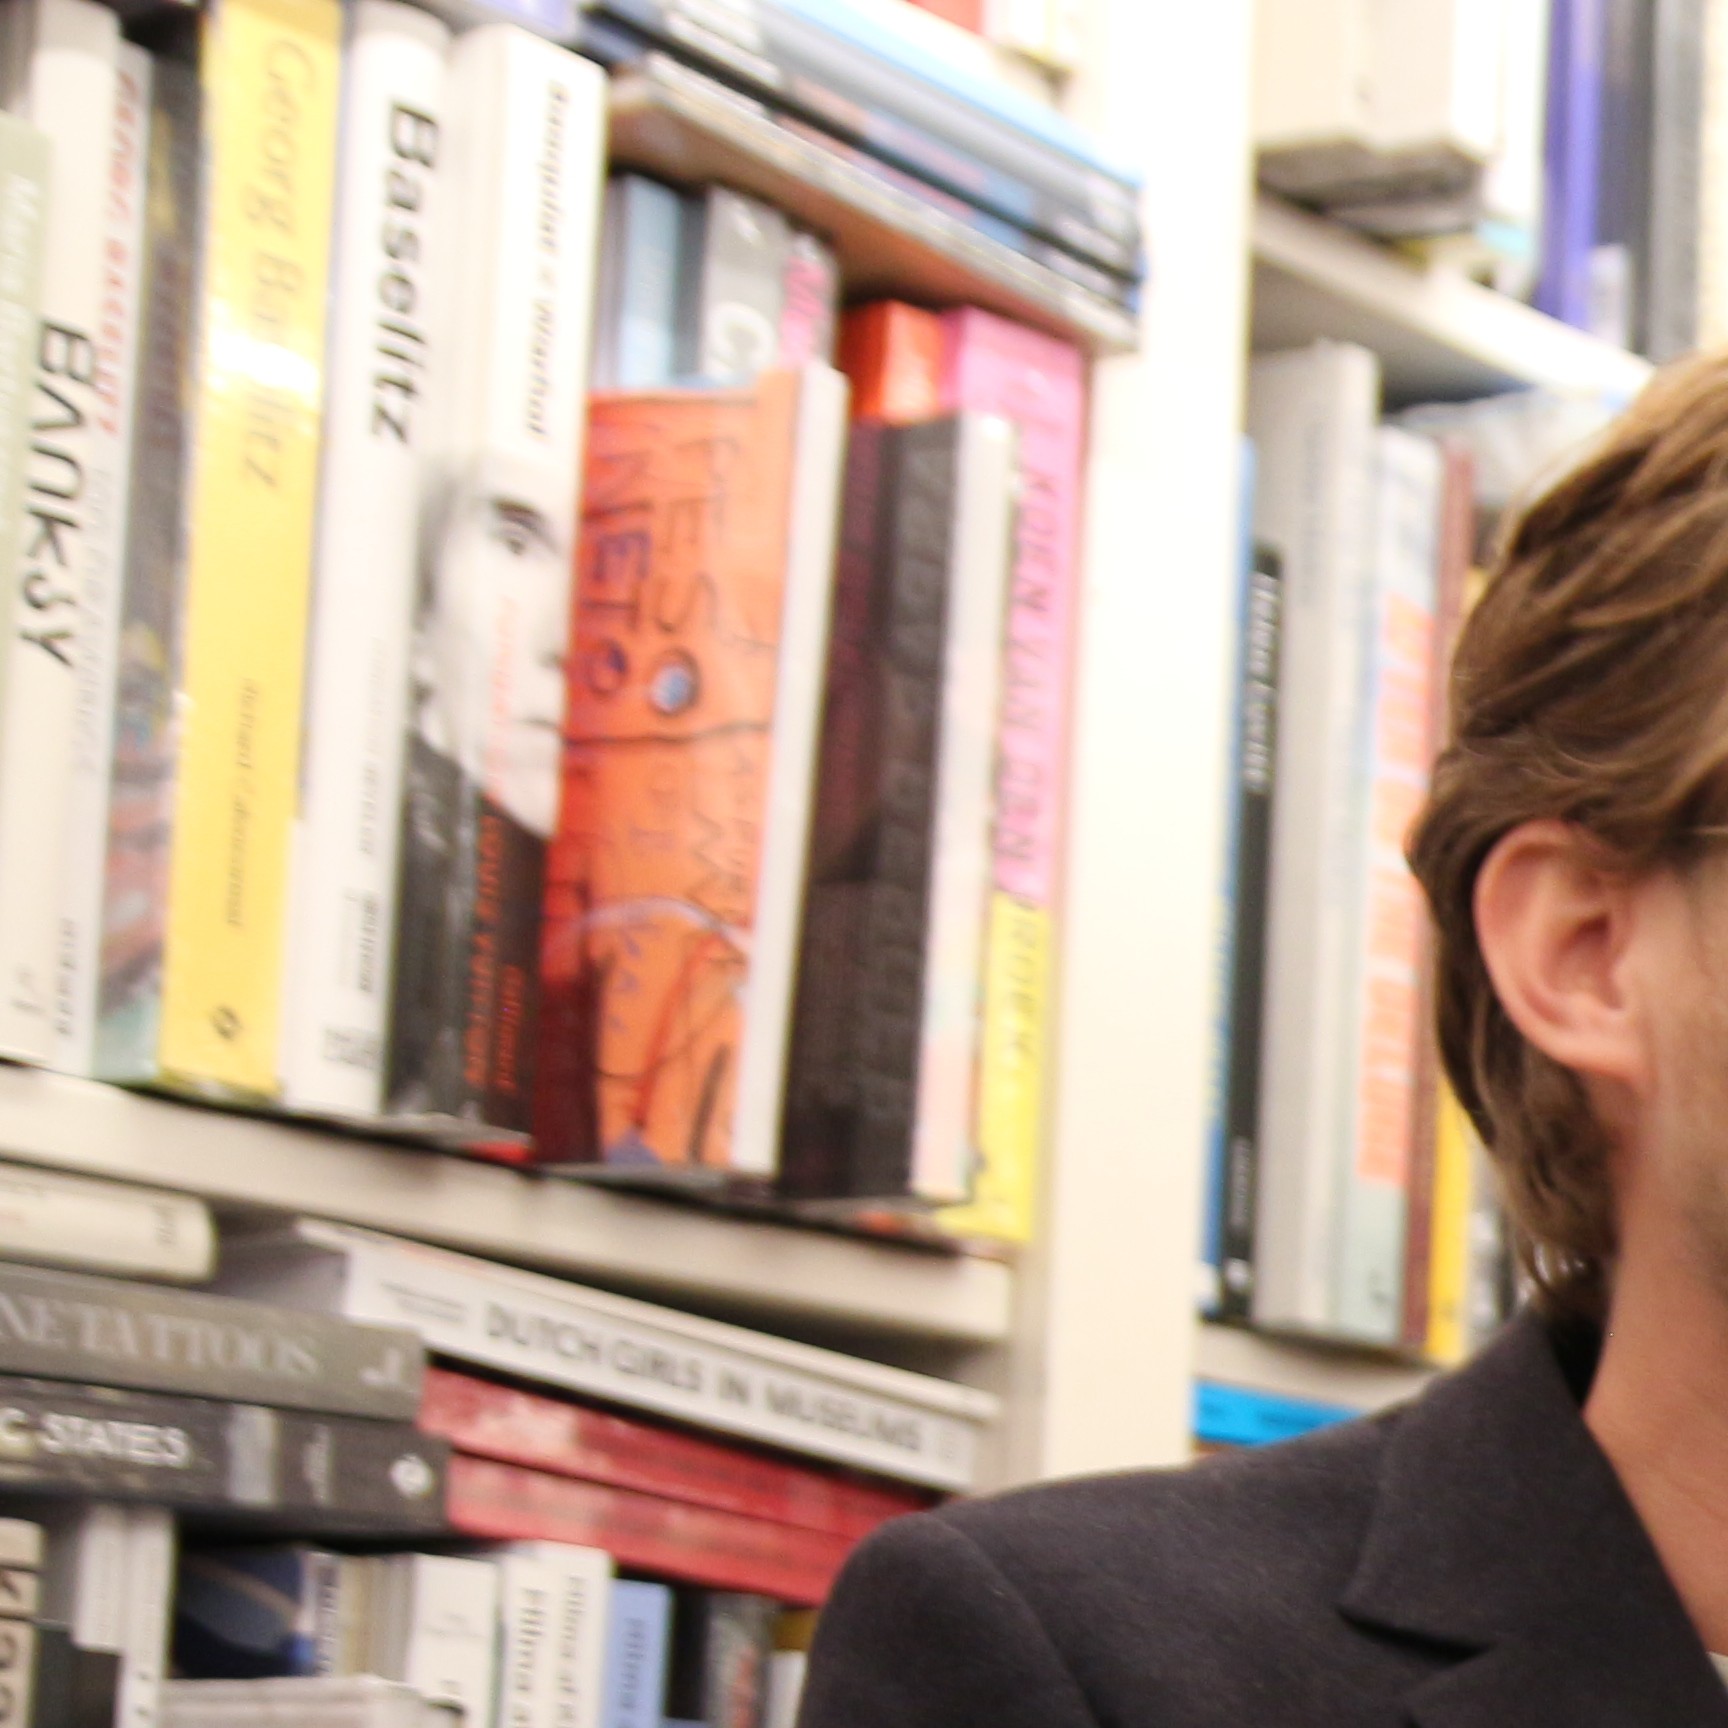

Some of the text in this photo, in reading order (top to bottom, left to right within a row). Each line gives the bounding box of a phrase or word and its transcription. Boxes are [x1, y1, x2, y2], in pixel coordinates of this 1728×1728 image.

[537, 81, 571, 256] Basquiat
[241, 38, 316, 489] Georg Balitz
[368, 97, 441, 445] Baselitz
[525, 299, 558, 442] Warhol
[16, 318, 95, 667] BANKSY
[1002, 636, 1053, 731] VAN
[80, 1302, 321, 1375] TATTOOS
[484, 1301, 599, 1361] DUTCH
[608, 1324, 700, 1390] GIRLS
[719, 1365, 752, 1403] IN
[764, 1379, 924, 1451] MUSEUMS
[42, 1411, 192, 1468] STATES
[515, 1588, 549, 1693] Hilma
[560, 1576, 588, 1660] Hilma
[620, 1618, 648, 1708] Hilma
[556, 1670, 583, 1698] af
